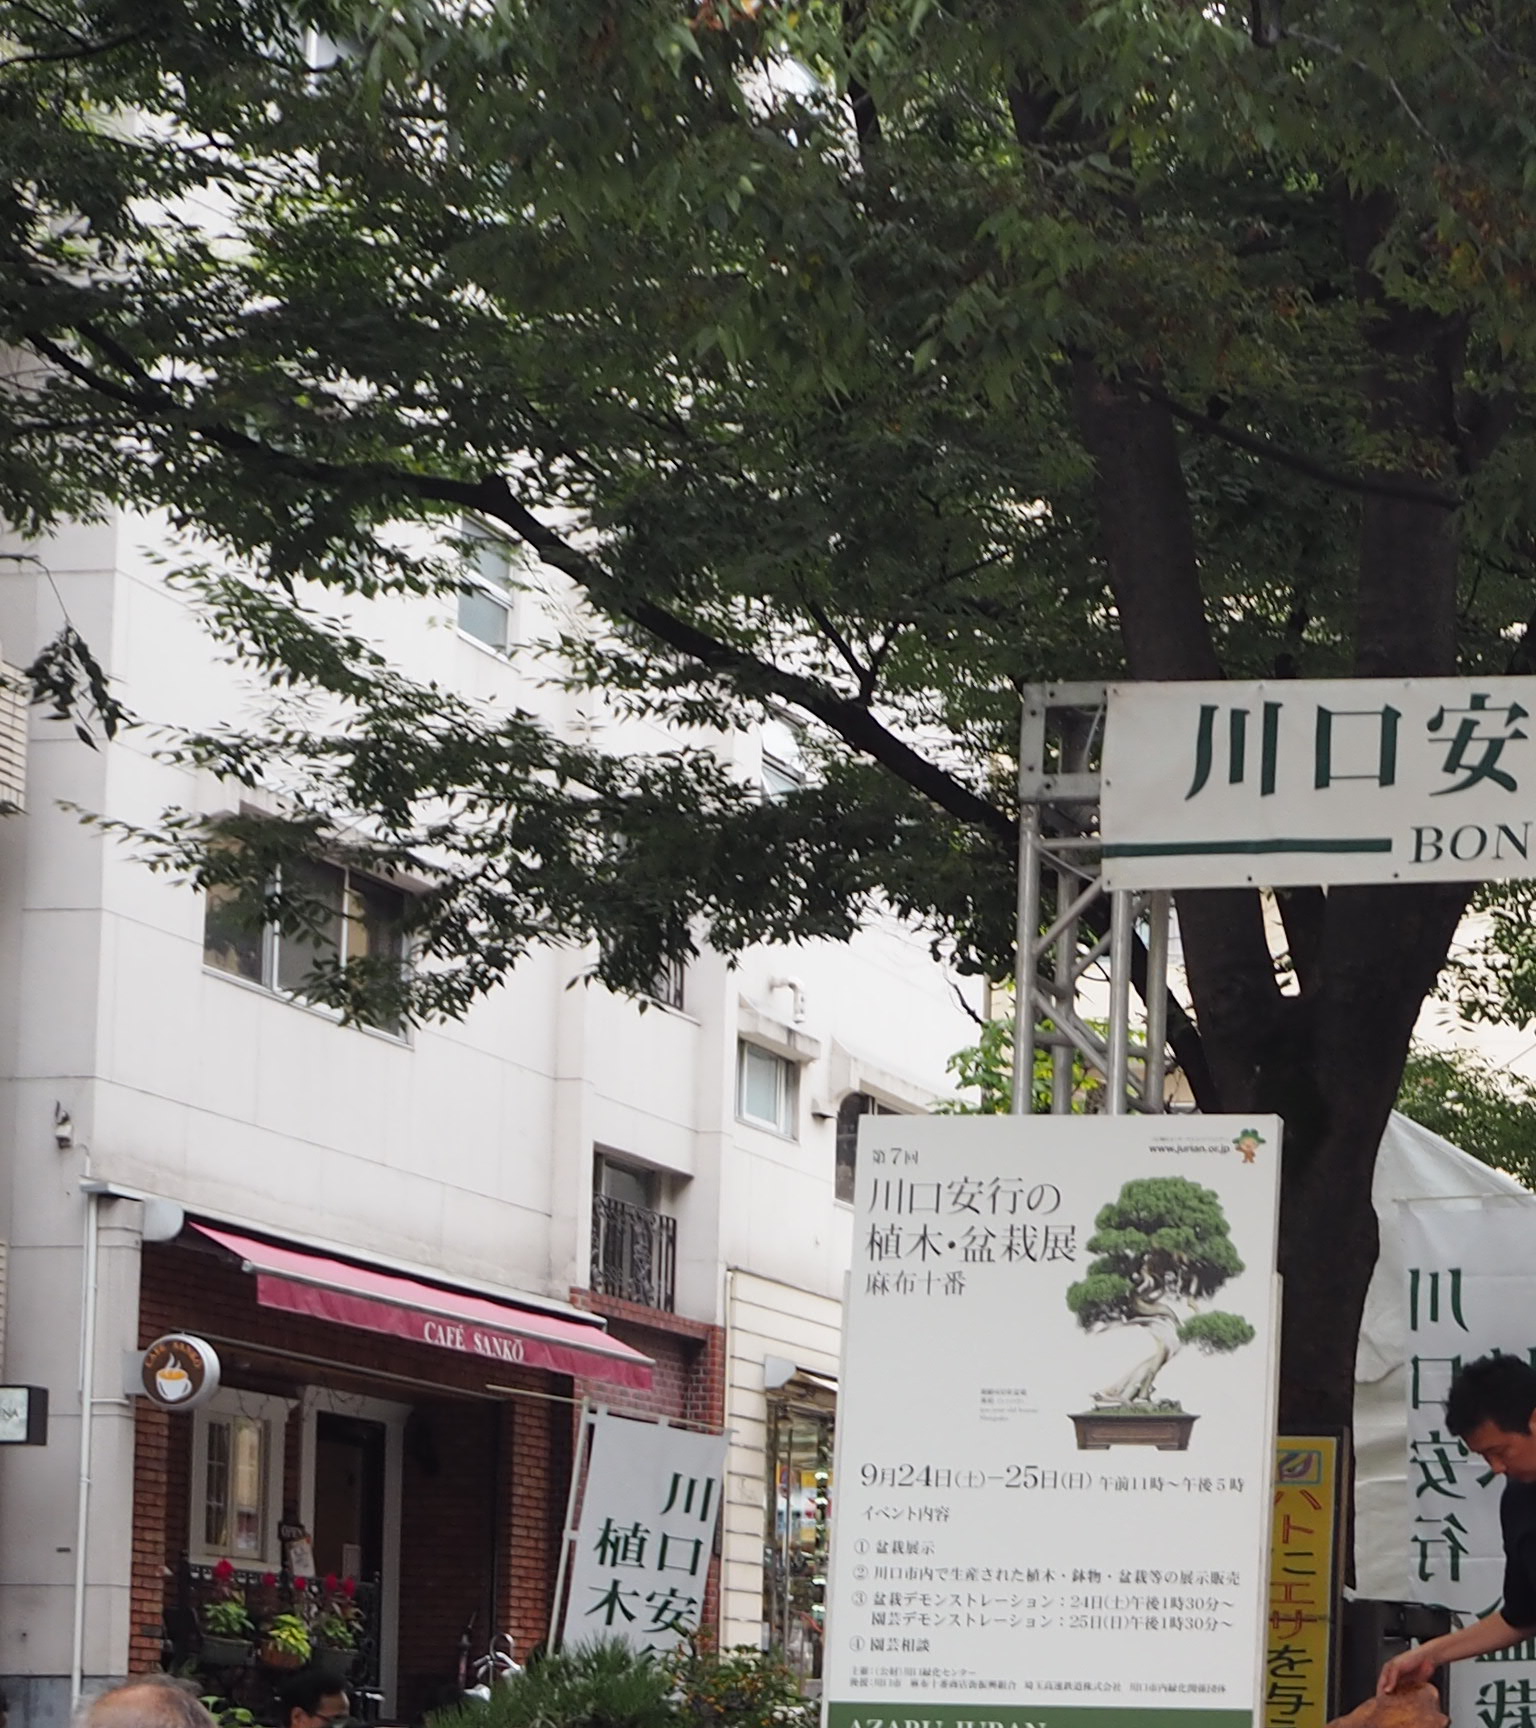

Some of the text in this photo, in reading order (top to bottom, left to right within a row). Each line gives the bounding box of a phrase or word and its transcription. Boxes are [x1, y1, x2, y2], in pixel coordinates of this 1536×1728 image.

[872, 1147, 919, 1166] 第7回
[867, 1175, 1061, 1216] 川口安行の
[865, 1223, 1077, 1264] 植木・盆栽展
[866, 1271, 967, 1296] 麻布十番
[863, 1504, 950, 1523] イベント内容
